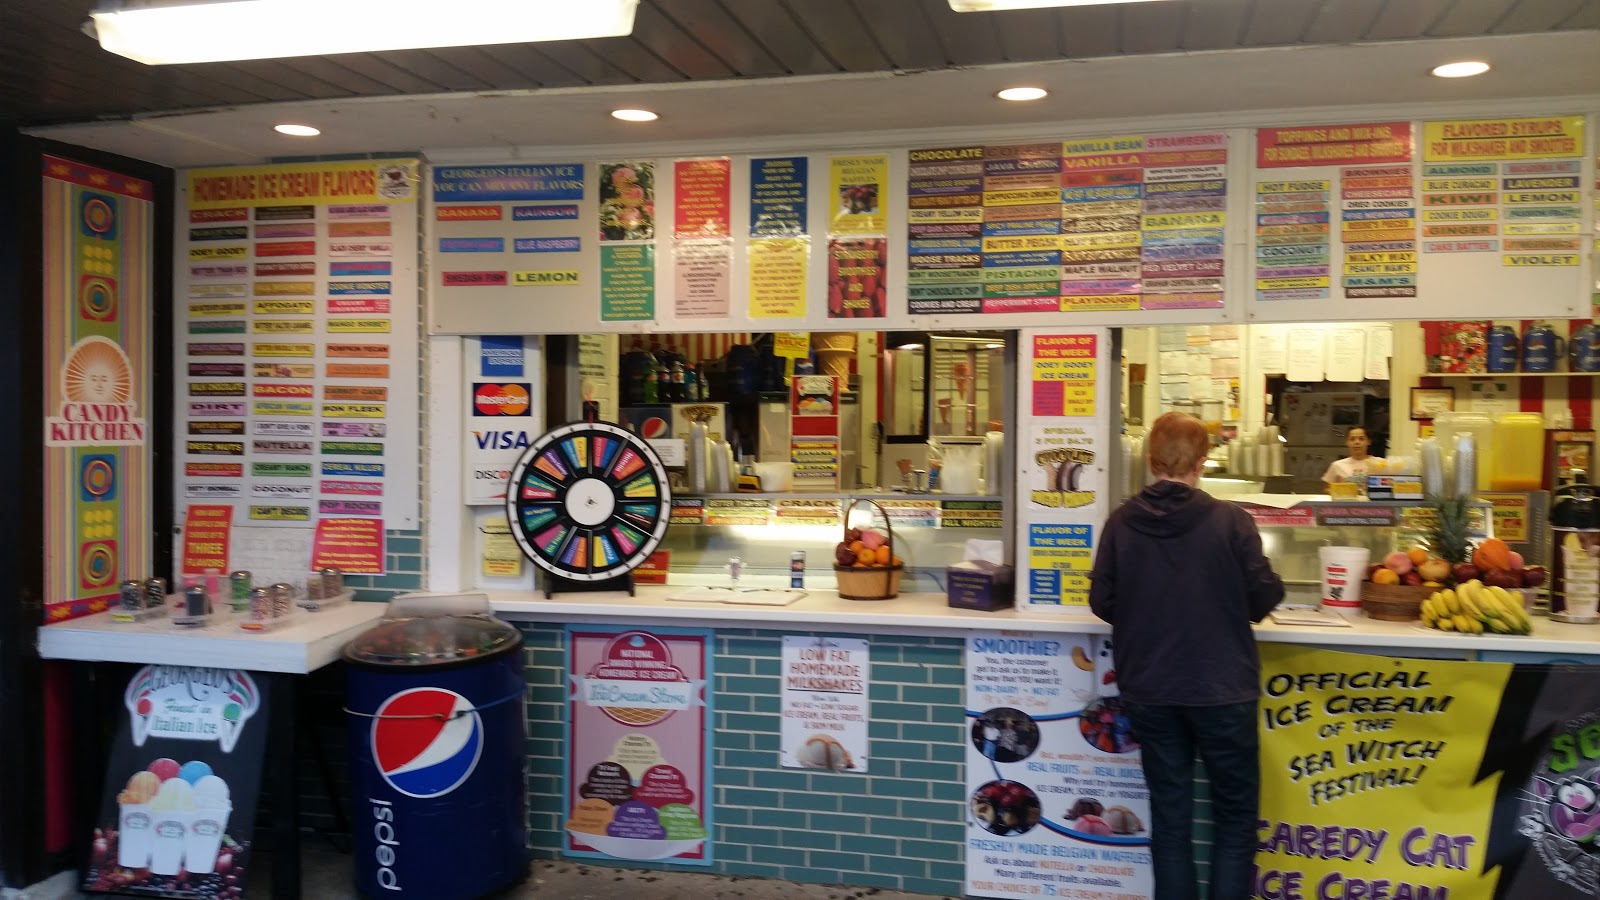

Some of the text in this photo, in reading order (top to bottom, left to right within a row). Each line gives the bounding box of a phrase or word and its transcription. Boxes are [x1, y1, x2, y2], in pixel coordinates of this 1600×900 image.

[1443, 120, 1563, 137] FLAVORED SYRUPS
[1147, 135, 1223, 148] STRAWBERRY
[1067, 144, 1110, 153] VANILLA
[911, 149, 982, 161] CHOCOLATE
[1064, 155, 1140, 168] VANILLA
[556, 167, 575, 176] ICE
[1346, 168, 1409, 177] BROWNIES
[259, 174, 277, 198] ICE
[281, 172, 320, 198] CREAM
[323, 170, 375, 196] FLAVORS
[1288, 182, 1323, 190] FUDGE
[1508, 179, 1573, 188] LAVENDER
[1430, 195, 1491, 203] KIWI
[1510, 194, 1573, 202] LEMON
[438, 209, 498, 217] BANANA
[1430, 226, 1490, 234] GINGER
[1262, 247, 1322, 256] COCONUT
[1350, 253, 1412, 262] MILKY WAY
[986, 269, 1057, 279] PISTACHIO
[1065, 266, 1096, 274] MAPLE
[516, 273, 577, 282] LEMON
[843, 299, 870, 309] SHAKES
[482, 349, 521, 357] AMERICAN
[254, 386, 312, 394] BACON
[476, 394, 528, 404] MasterCard
[63, 404, 133, 421] CANDY
[51, 423, 143, 440] KITCHEN
[473, 430, 530, 450] VISA
[254, 441, 311, 450] NUTELLA
[476, 470, 511, 481] DISCO
[1032, 526, 1073, 535] FLAVOR
[1033, 538, 1087, 547] THE WEEK
[189, 543, 224, 554] THREE
[973, 638, 1061, 656] SMOOTHIE?
[620, 649, 654, 658] NATIONAL
[831, 649, 851, 662] FAT
[790, 663, 860, 677] HOMEMADE
[787, 676, 863, 691] MILKSHAKES
[1265, 671, 1432, 698] OFFICIAL
[1263, 695, 1455, 730] ICE CREAM
[152, 718, 218, 734] Italian Ice
[1317, 718, 1396, 739] OF THE
[1289, 739, 1447, 782] SEA WITCH
[1309, 764, 1429, 807] FESTIVAL!
[369, 798, 402, 891] pepsi
[1257, 819, 1478, 870] CAREDY CAT
